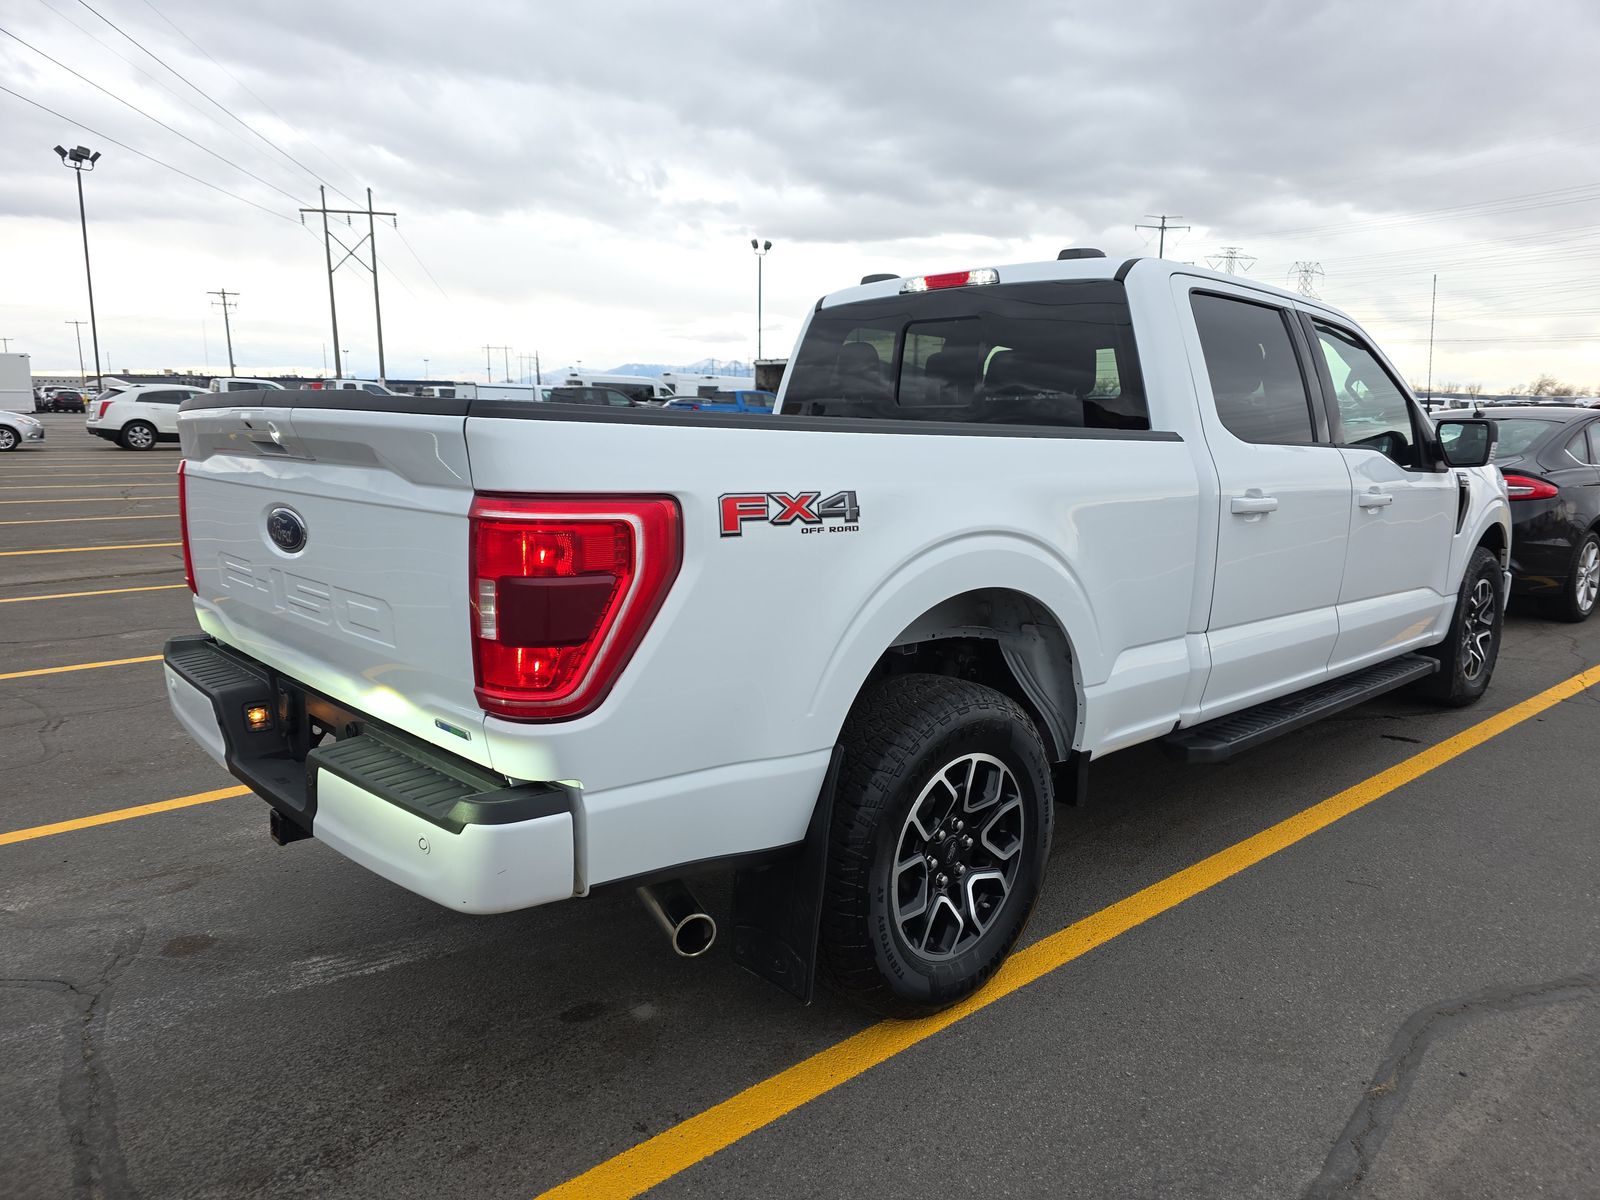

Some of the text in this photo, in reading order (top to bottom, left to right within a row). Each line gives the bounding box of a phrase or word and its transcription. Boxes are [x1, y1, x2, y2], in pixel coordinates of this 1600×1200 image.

[271, 516, 294, 544] Ford
[718, 491, 860, 538] FX4
[801, 525, 860, 535] OFF ROAD
[878, 915, 905, 980] TERRITORY
